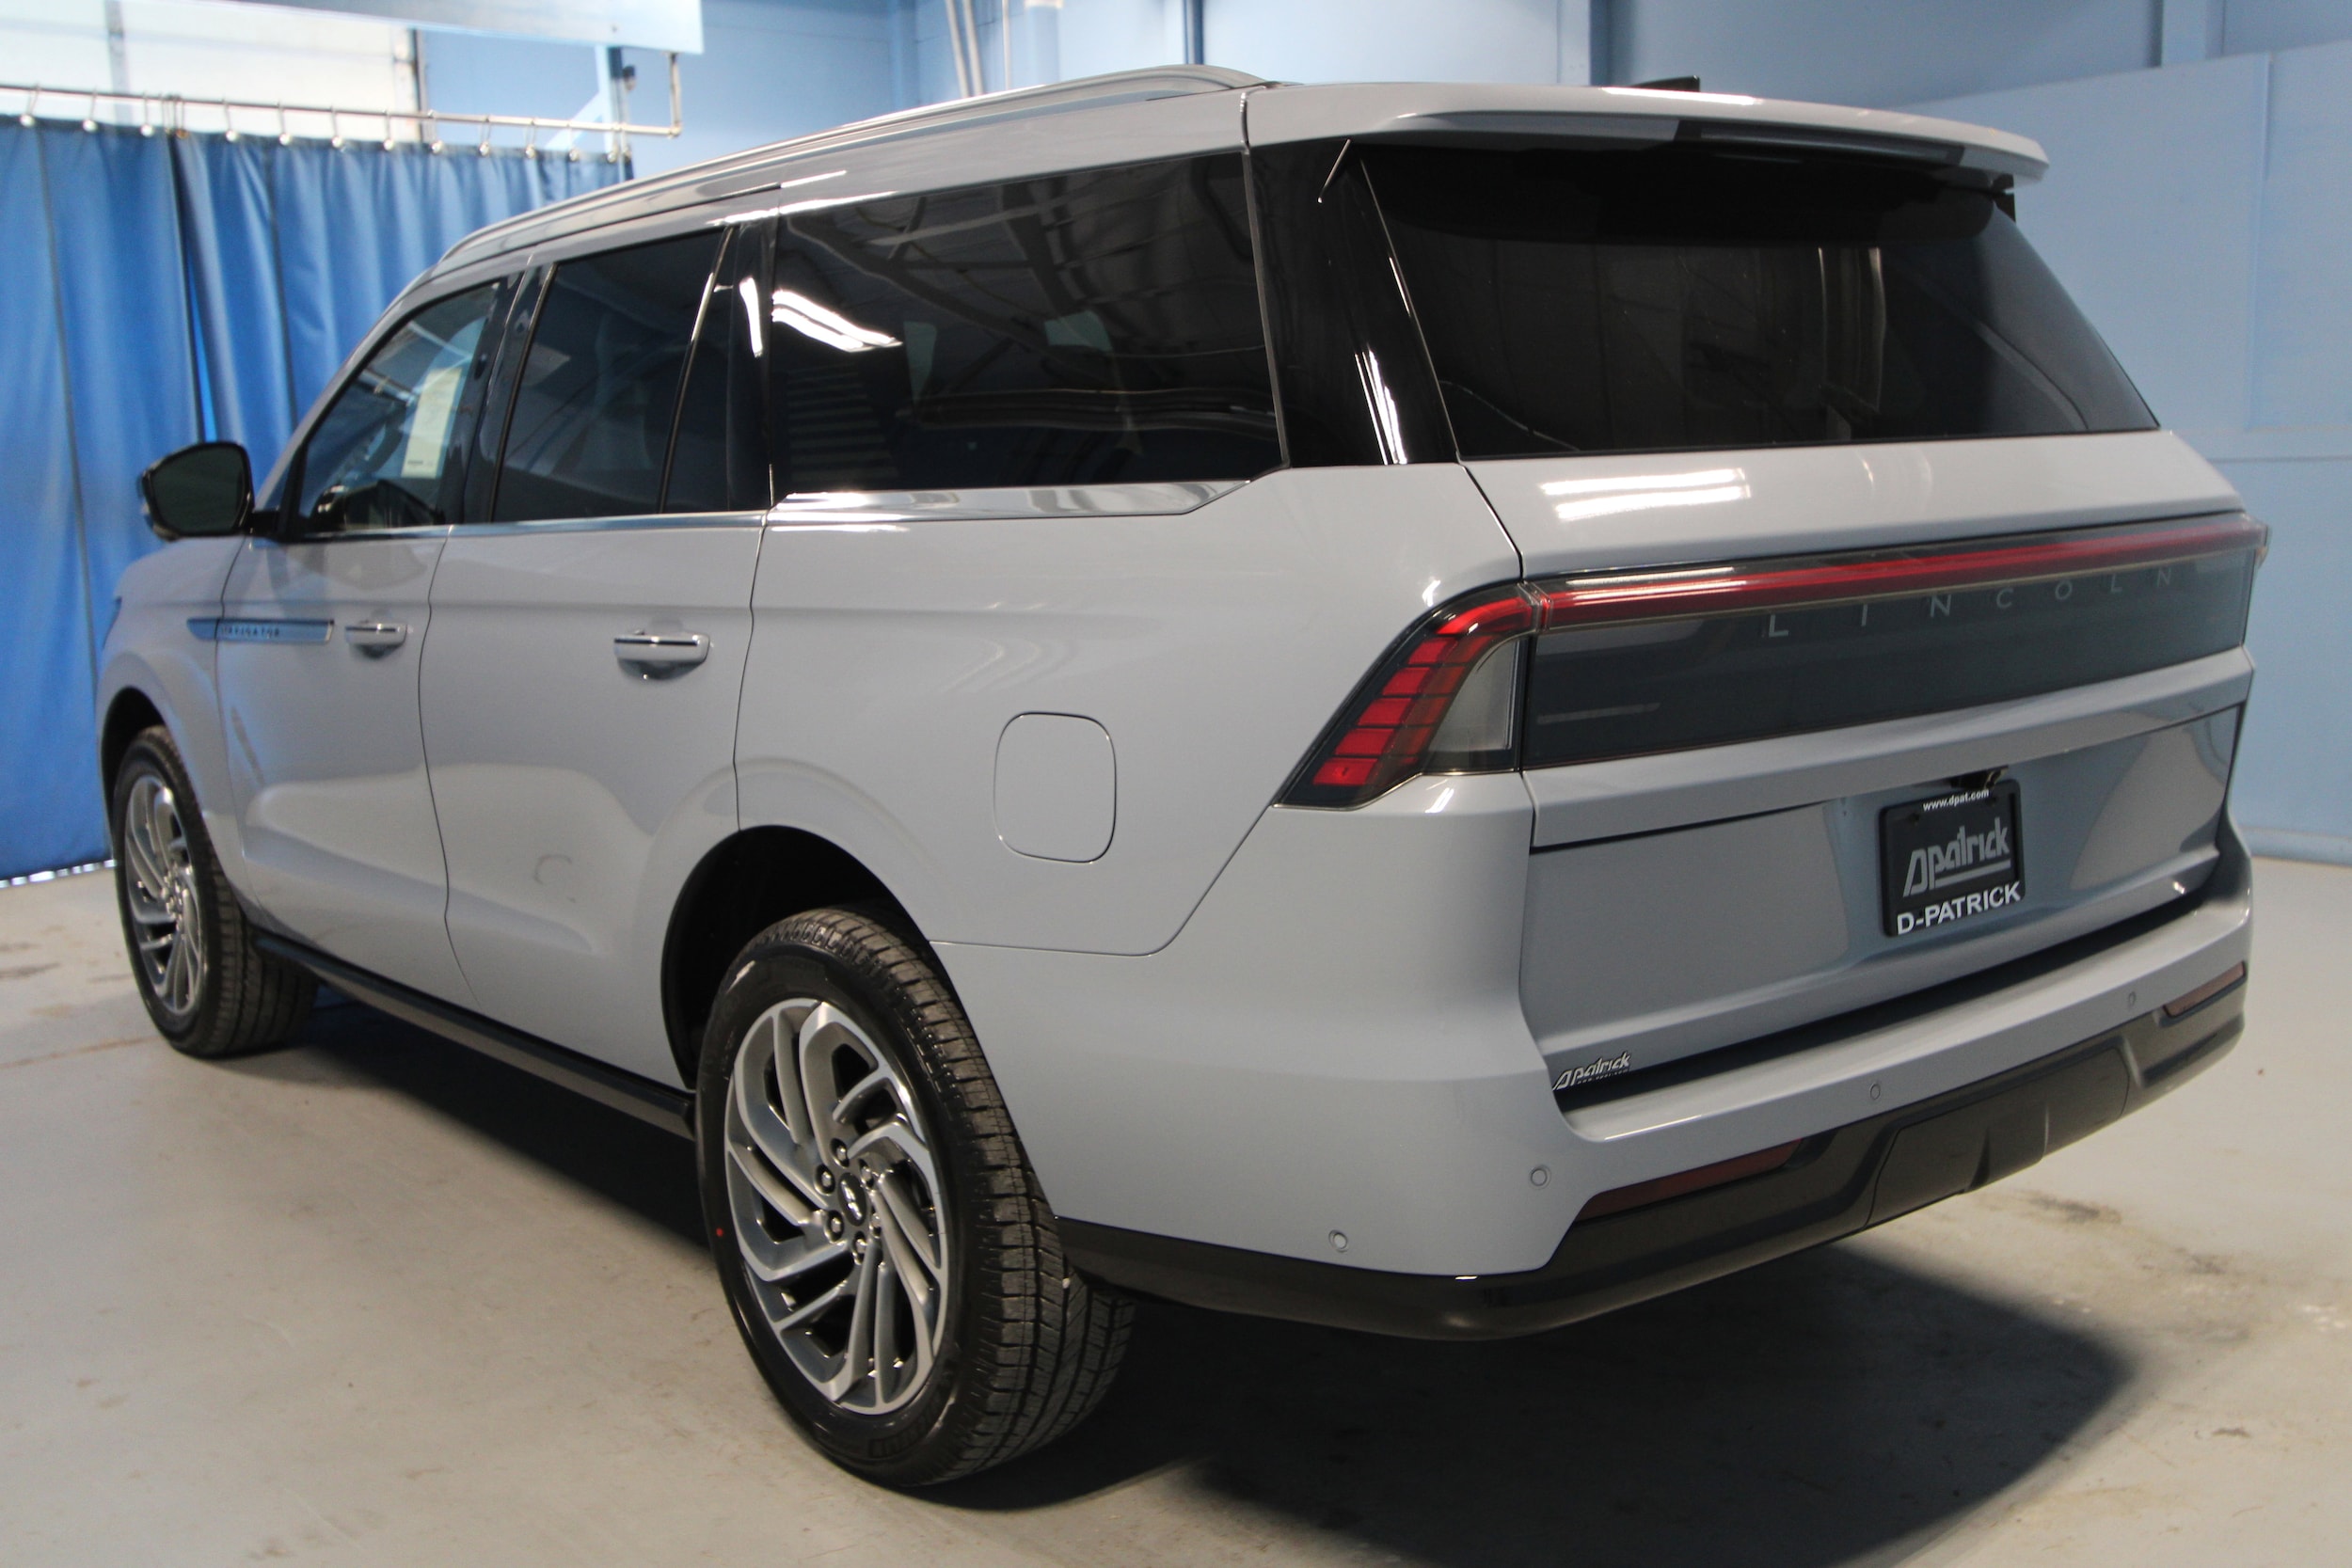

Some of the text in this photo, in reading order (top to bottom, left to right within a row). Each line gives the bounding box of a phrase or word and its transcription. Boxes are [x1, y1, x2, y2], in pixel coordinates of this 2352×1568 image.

[1768, 567, 2171, 638] LINCOLN
[1923, 789, 1990, 811] www.dpat.com
[1897, 880, 2021, 935] D-PATRICK
